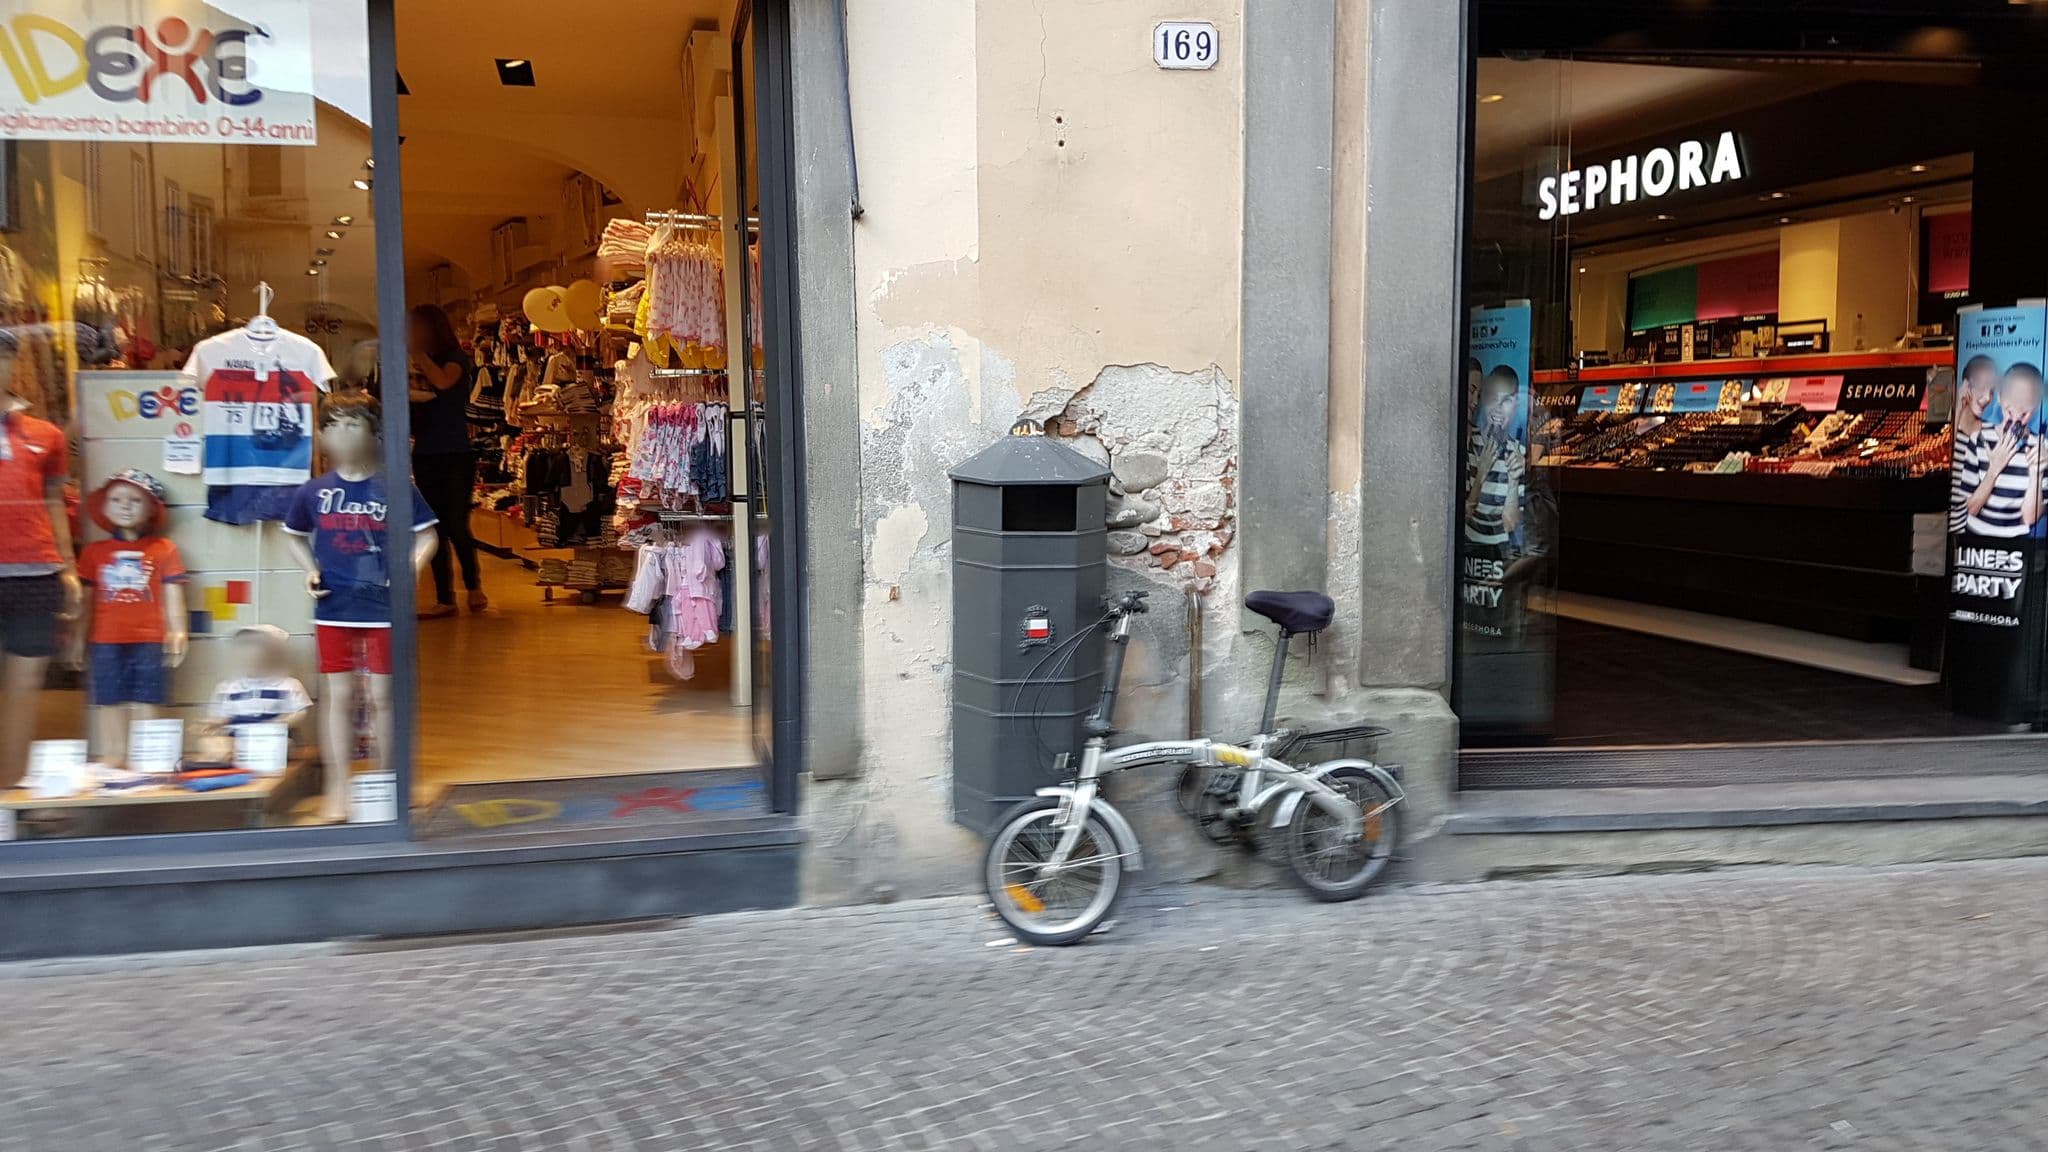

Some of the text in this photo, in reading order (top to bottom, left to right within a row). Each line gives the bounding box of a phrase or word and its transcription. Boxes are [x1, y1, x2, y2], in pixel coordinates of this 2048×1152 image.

[1161, 30, 1211, 61] 169
[117, 112, 210, 136] bambino
[216, 116, 266, 138] 0-14
[268, 118, 313, 140] anni
[1539, 131, 1741, 221] SEPHORA
[1535, 395, 1576, 406] SEPHORA
[1846, 384, 1916, 399] SEPHORA
[317, 487, 388, 521] Navy
[1955, 546, 2023, 571] LINERS
[1954, 573, 2022, 599] PARTY
[1975, 612, 2019, 625] SEPHORA
